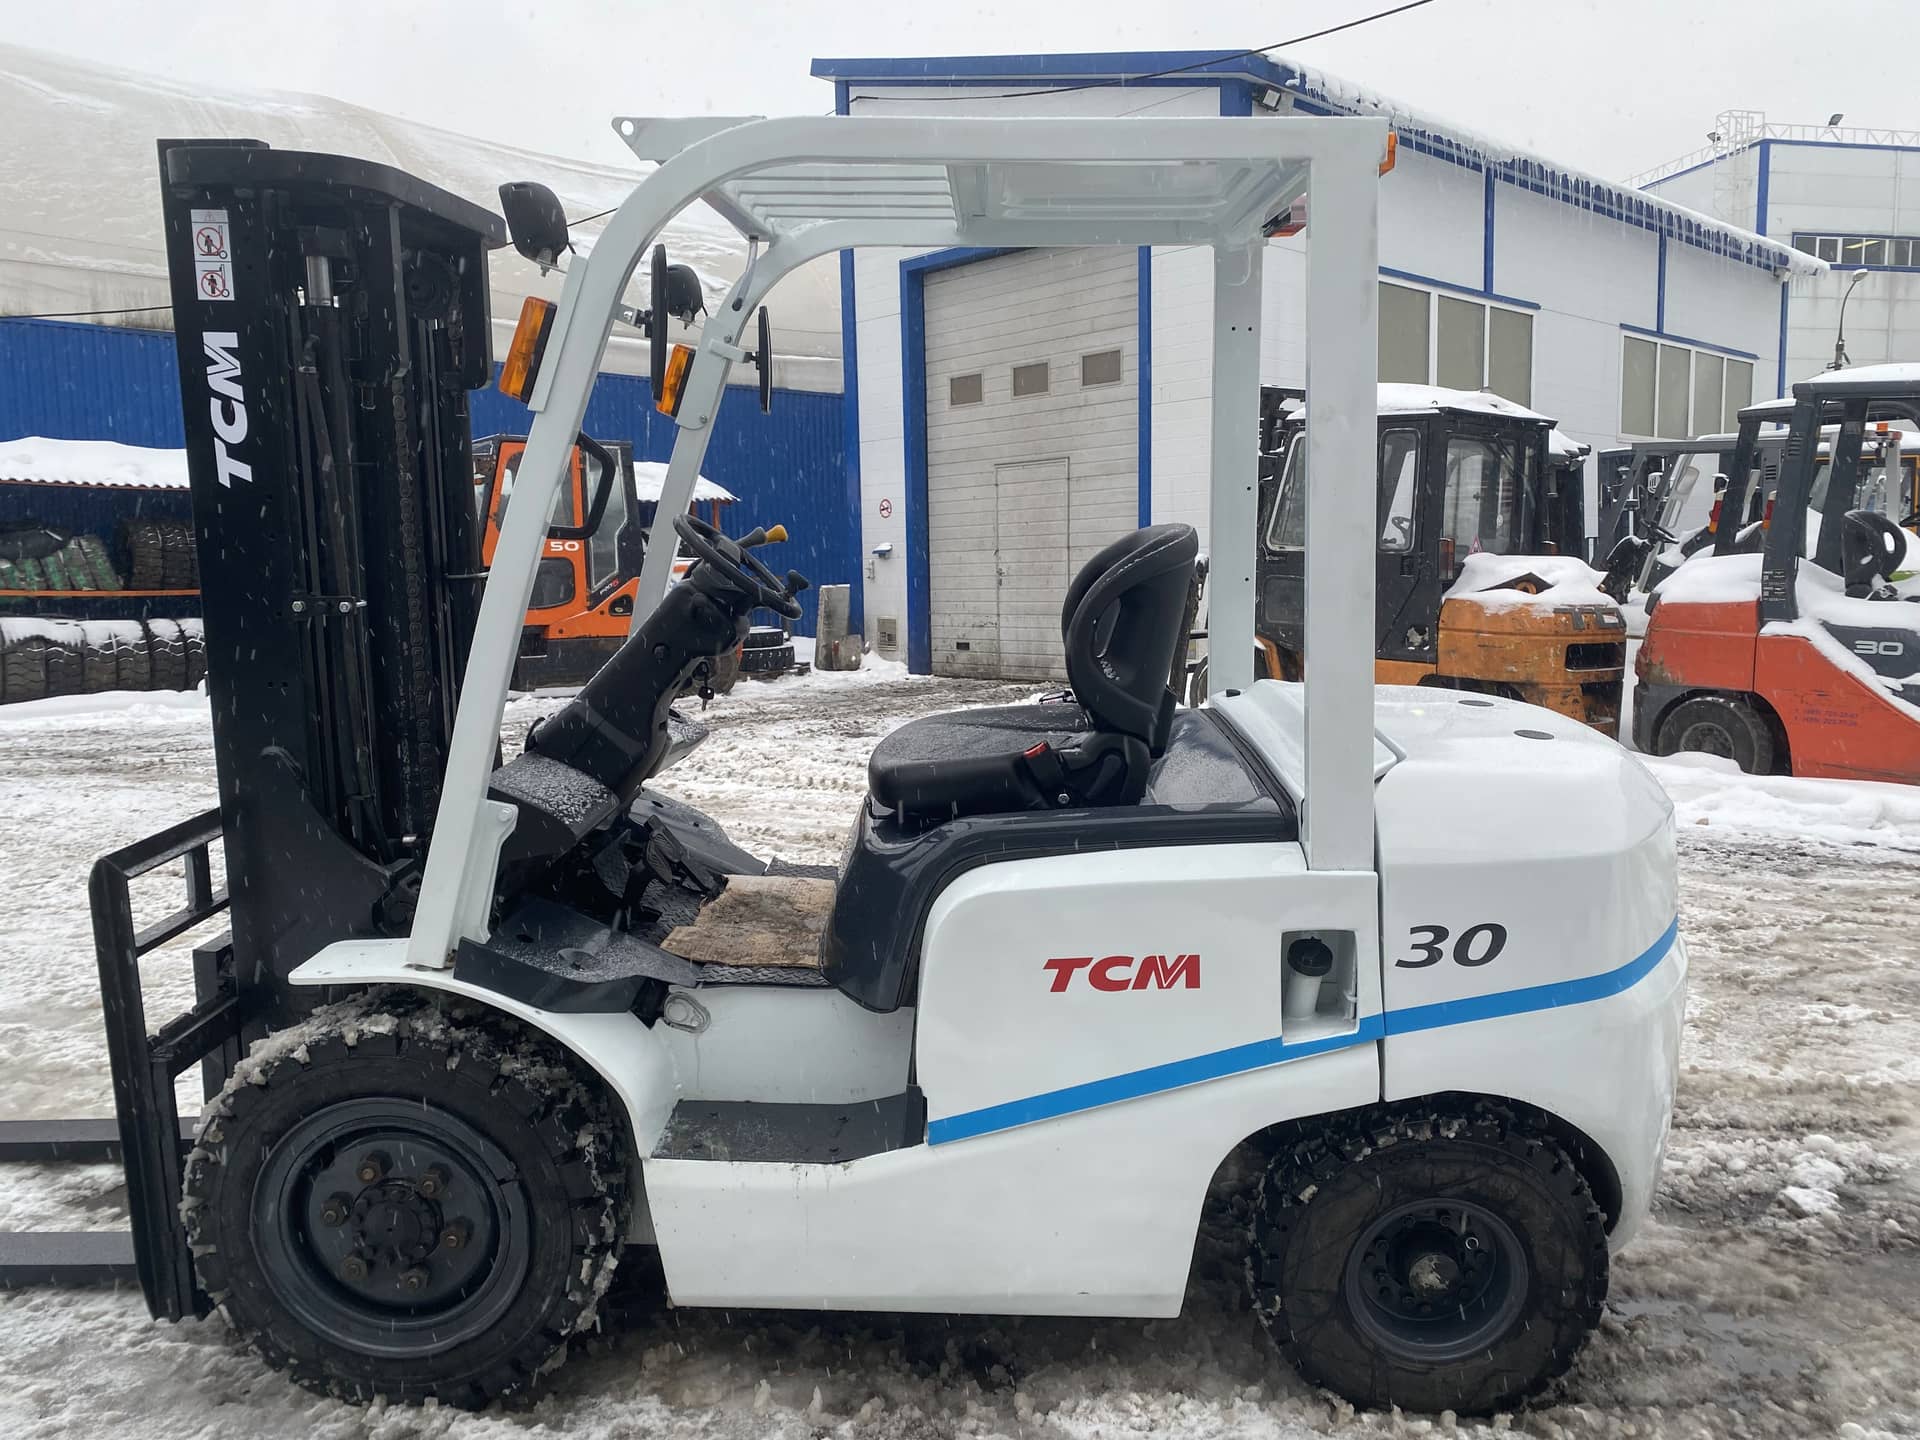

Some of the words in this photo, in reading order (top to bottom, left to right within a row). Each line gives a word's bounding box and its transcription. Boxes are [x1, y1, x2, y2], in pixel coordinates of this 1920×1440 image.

[202, 331, 253, 489] TCM
[550, 541, 579, 551] 50
[1854, 640, 1904, 656] 30
[1395, 923, 1507, 968] 30
[1043, 954, 1200, 993] TCM
